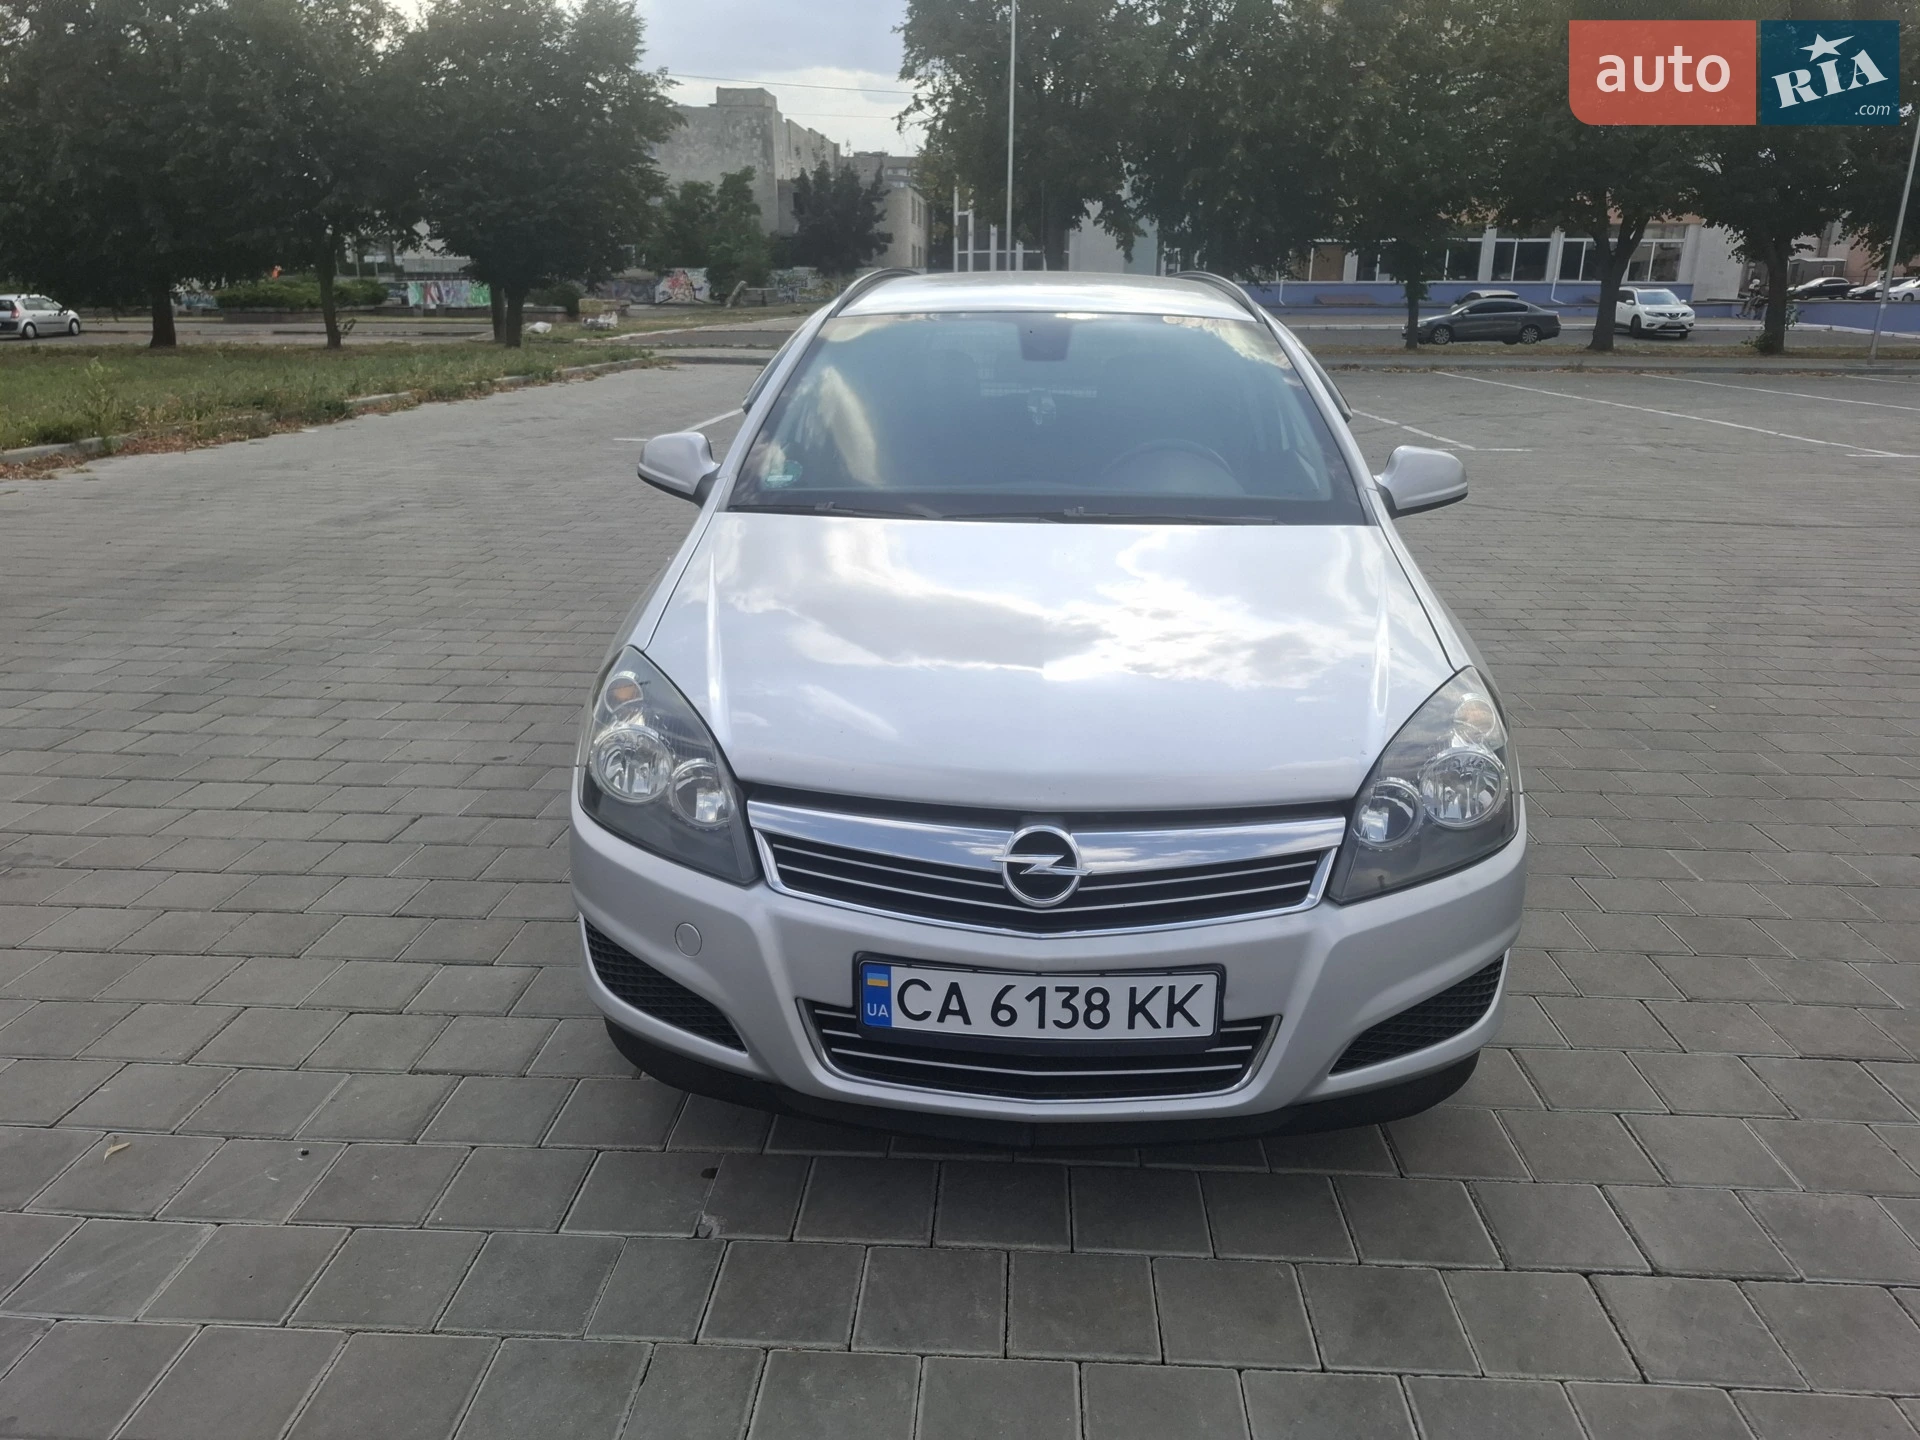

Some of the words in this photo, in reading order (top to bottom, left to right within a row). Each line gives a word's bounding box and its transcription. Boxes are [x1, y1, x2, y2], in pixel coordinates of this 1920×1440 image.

[867, 1003, 889, 1018] UA
[897, 978, 972, 1025] CA
[990, 984, 1110, 1030] 6138
[1127, 983, 1203, 1030] KK
